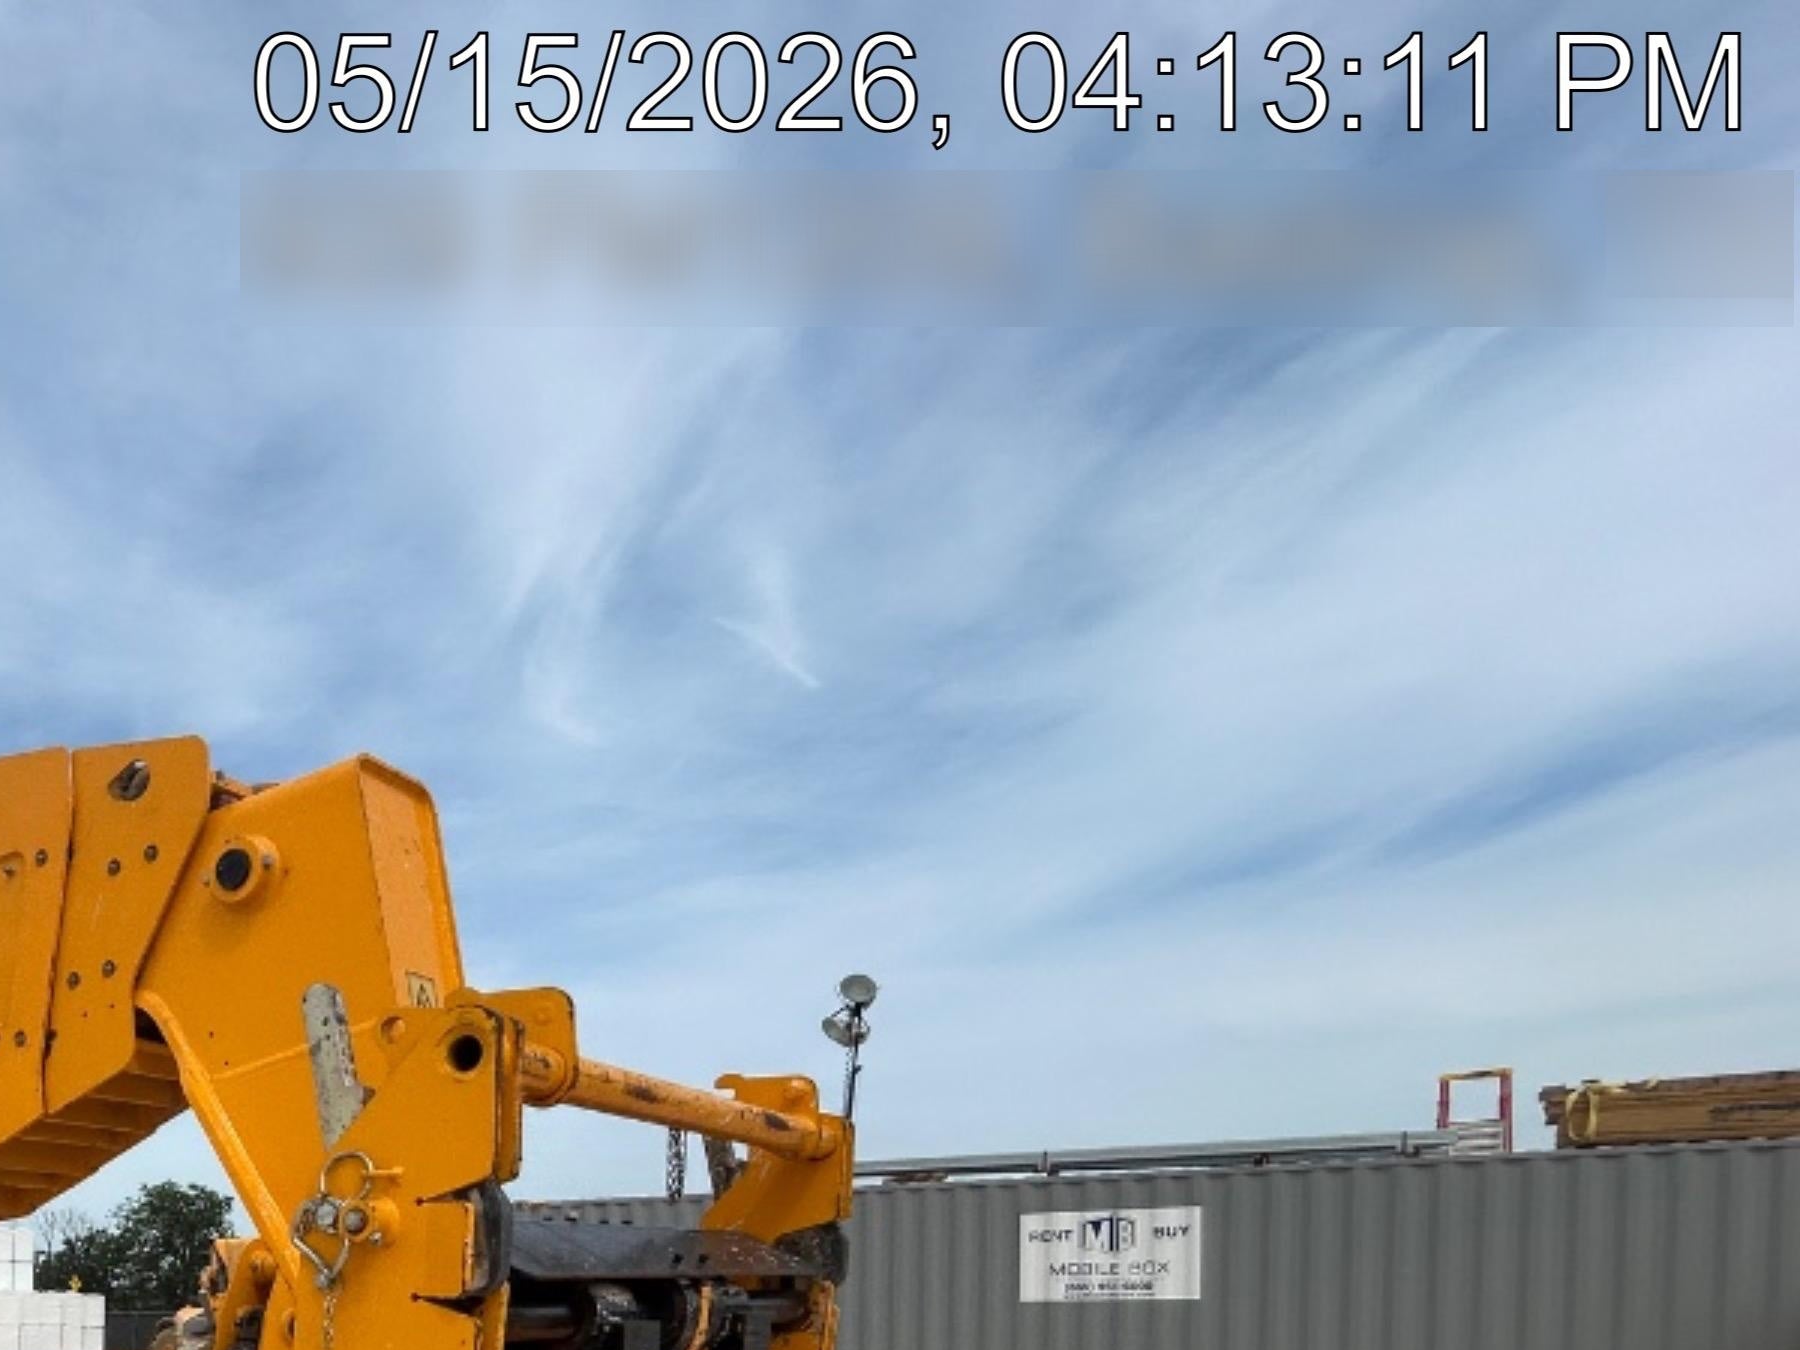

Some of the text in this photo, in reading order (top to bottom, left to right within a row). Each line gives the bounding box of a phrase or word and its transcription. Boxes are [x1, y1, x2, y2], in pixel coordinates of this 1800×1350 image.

[1028, 1228, 1074, 1243] RENT
[1152, 1223, 1191, 1240] BUY
[1048, 1259, 1170, 1277] MOBILE BOX
